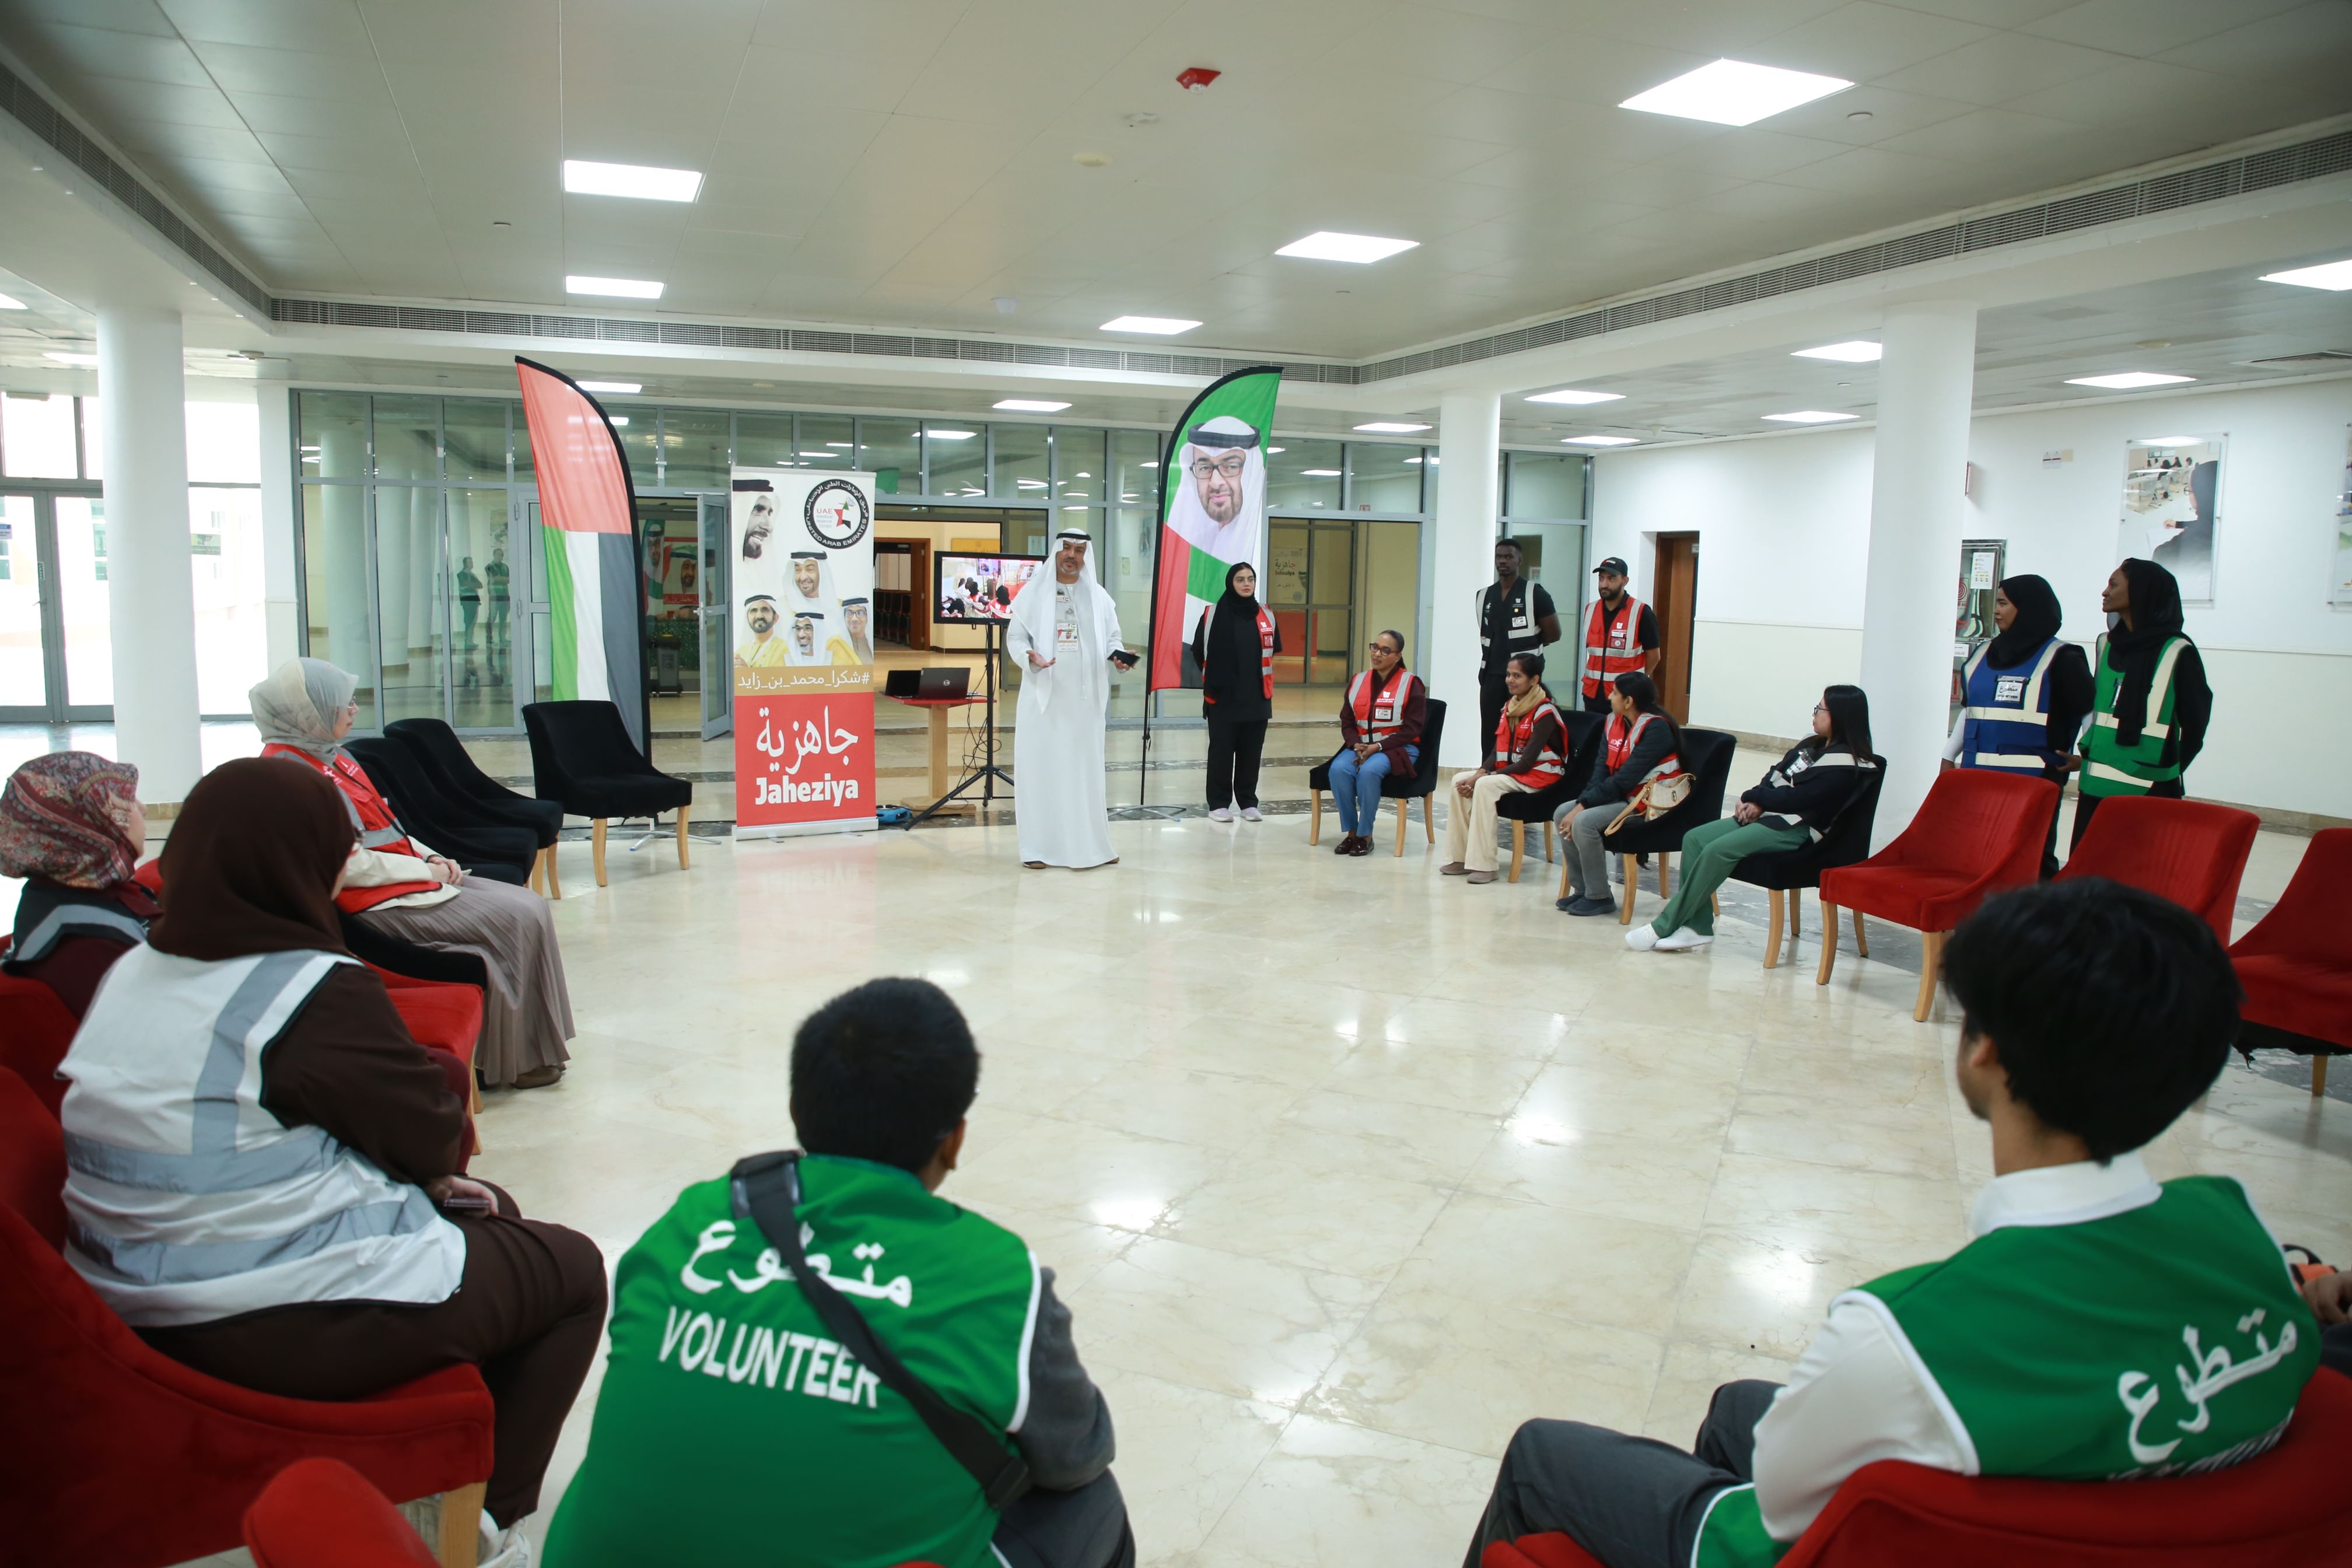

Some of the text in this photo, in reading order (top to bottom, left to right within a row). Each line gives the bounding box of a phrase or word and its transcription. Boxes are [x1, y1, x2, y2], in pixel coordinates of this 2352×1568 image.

[806, 517, 822, 541] UNITED
[843, 519, 867, 545] EMIRATES
[757, 705, 859, 775] جاهزية
[755, 773, 859, 807] Jaheziya
